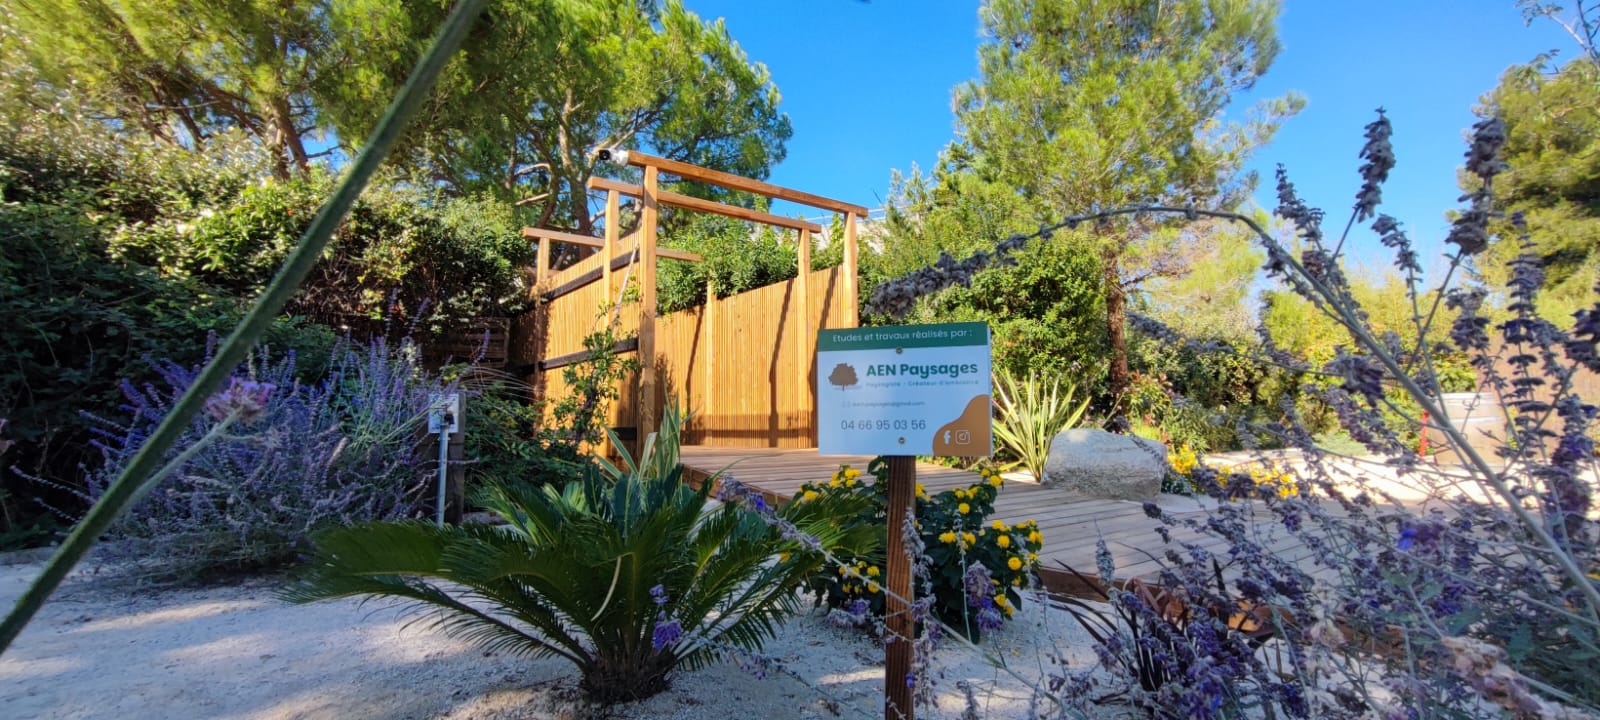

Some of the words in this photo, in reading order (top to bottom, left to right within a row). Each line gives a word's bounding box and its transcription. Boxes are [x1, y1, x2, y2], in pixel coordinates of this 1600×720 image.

[833, 334, 862, 343] Etudes
[864, 333, 873, 341] et
[875, 332, 910, 341] travaux
[912, 330, 948, 339] réalisés
[950, 330, 968, 340] par
[866, 364, 897, 377] AEN
[900, 363, 978, 379] Paysages
[841, 420, 855, 431] 04
[858, 420, 873, 431] 66
[876, 419, 890, 430] 95
[893, 419, 908, 430] 03
[911, 419, 927, 430] 56
